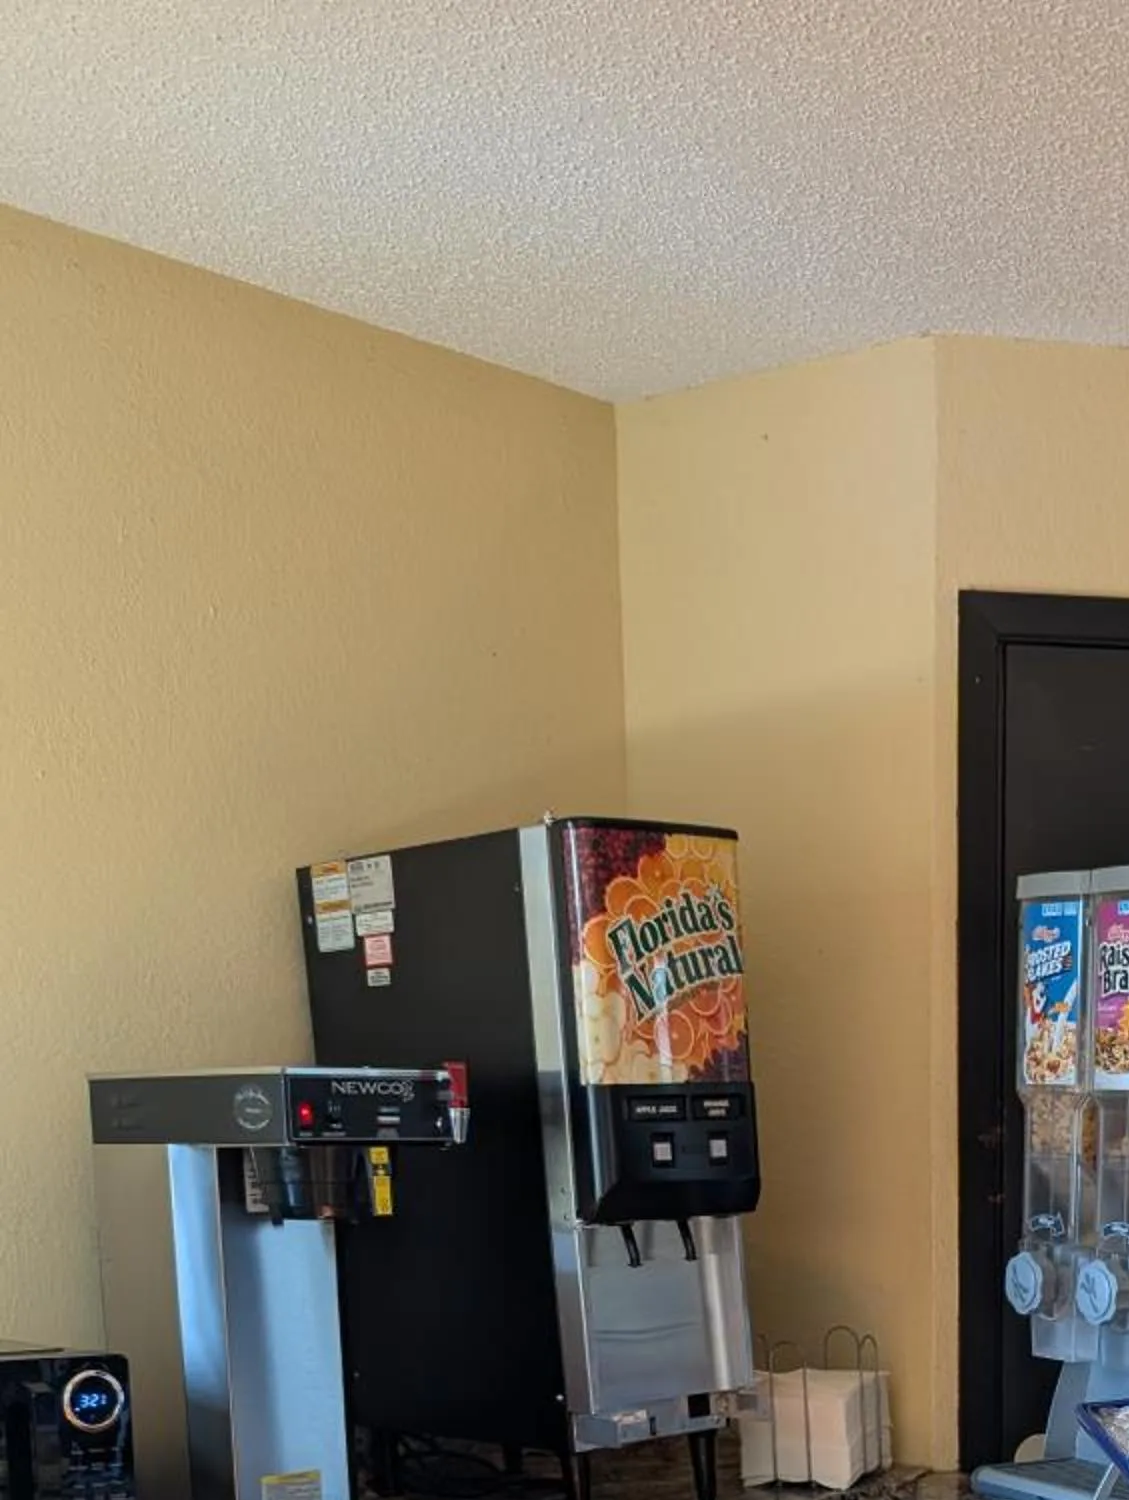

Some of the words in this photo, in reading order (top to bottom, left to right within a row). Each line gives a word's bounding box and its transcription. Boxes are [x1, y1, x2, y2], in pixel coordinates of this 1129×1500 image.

[608, 887, 734, 972] Florida's
[625, 936, 743, 1020] Ntural
[331, 1080, 404, 1095] NEWCO
